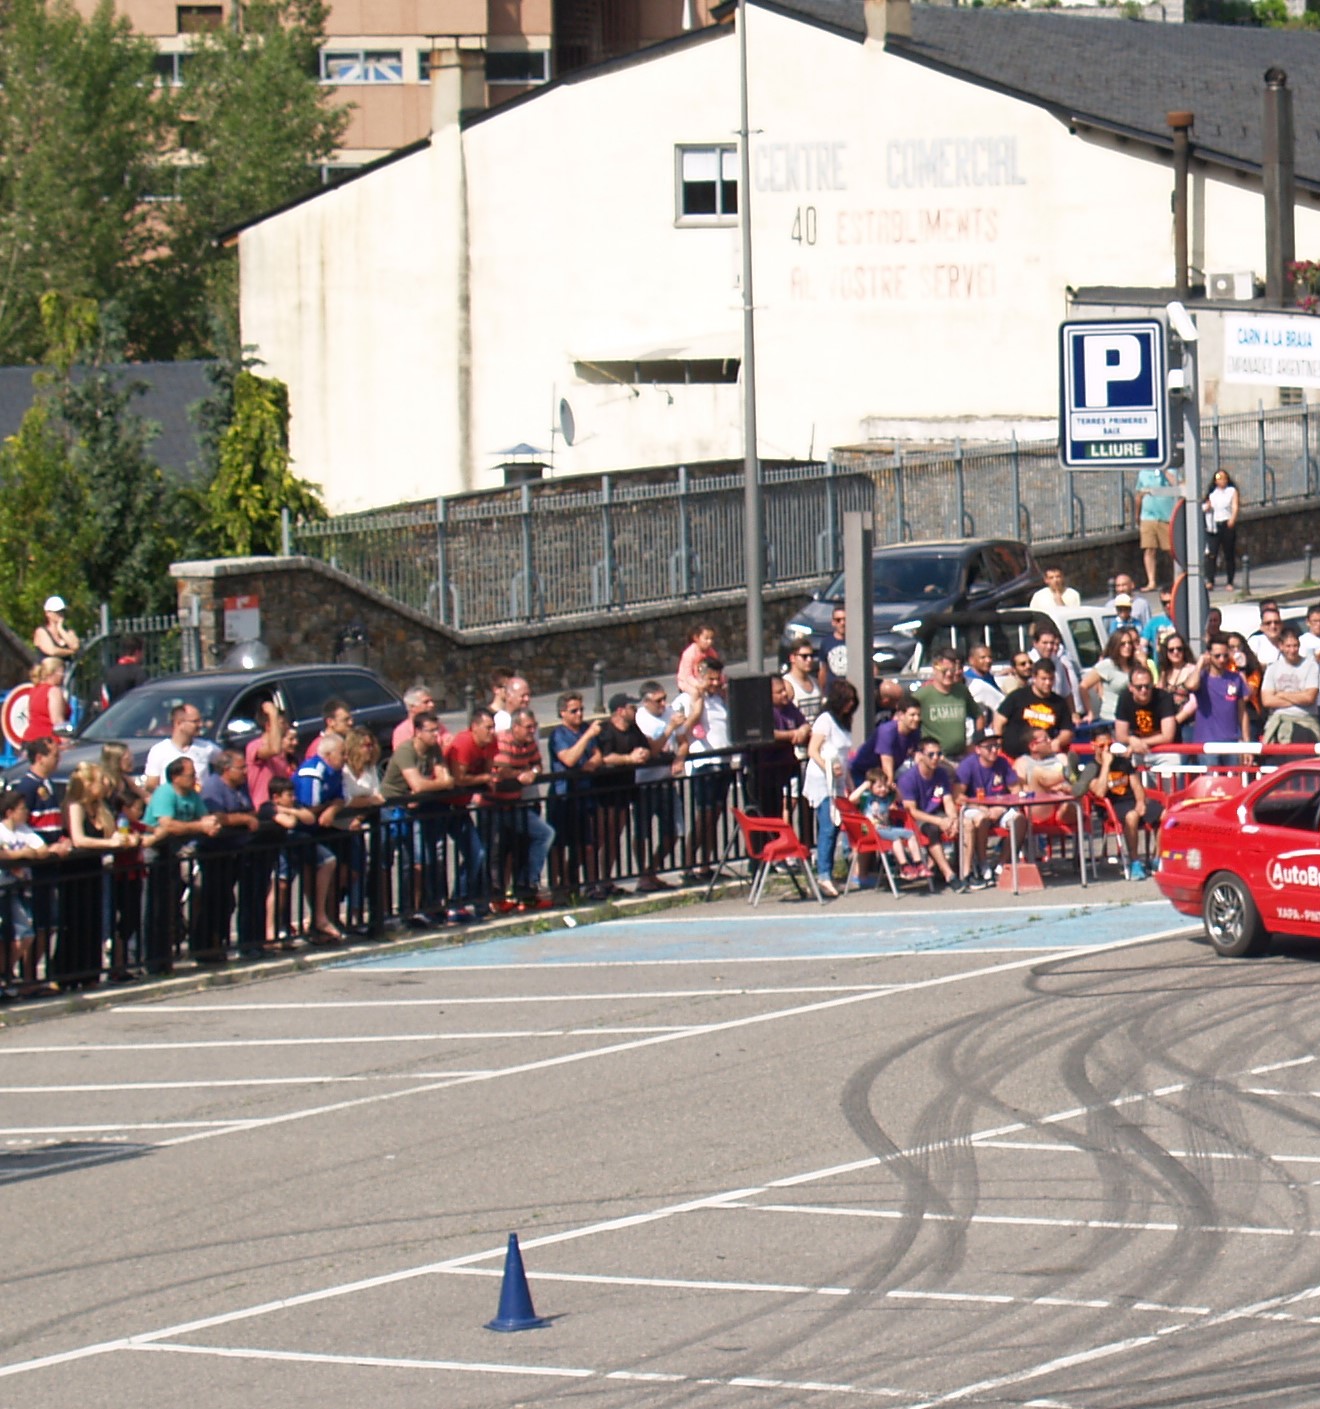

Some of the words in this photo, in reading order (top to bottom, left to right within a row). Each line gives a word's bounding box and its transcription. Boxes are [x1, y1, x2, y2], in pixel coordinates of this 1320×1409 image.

[754, 140, 848, 193] CENTRE
[886, 134, 1028, 190] COMERCIAL
[790, 206, 817, 246] 40
[920, 261, 998, 302] SERVEI
[1237, 327, 1260, 345] CARN
[1264, 328, 1270, 345] A
[1272, 328, 1283, 346] LA
[1084, 335, 1141, 408] P
[1090, 443, 1143, 457] LLIURE
